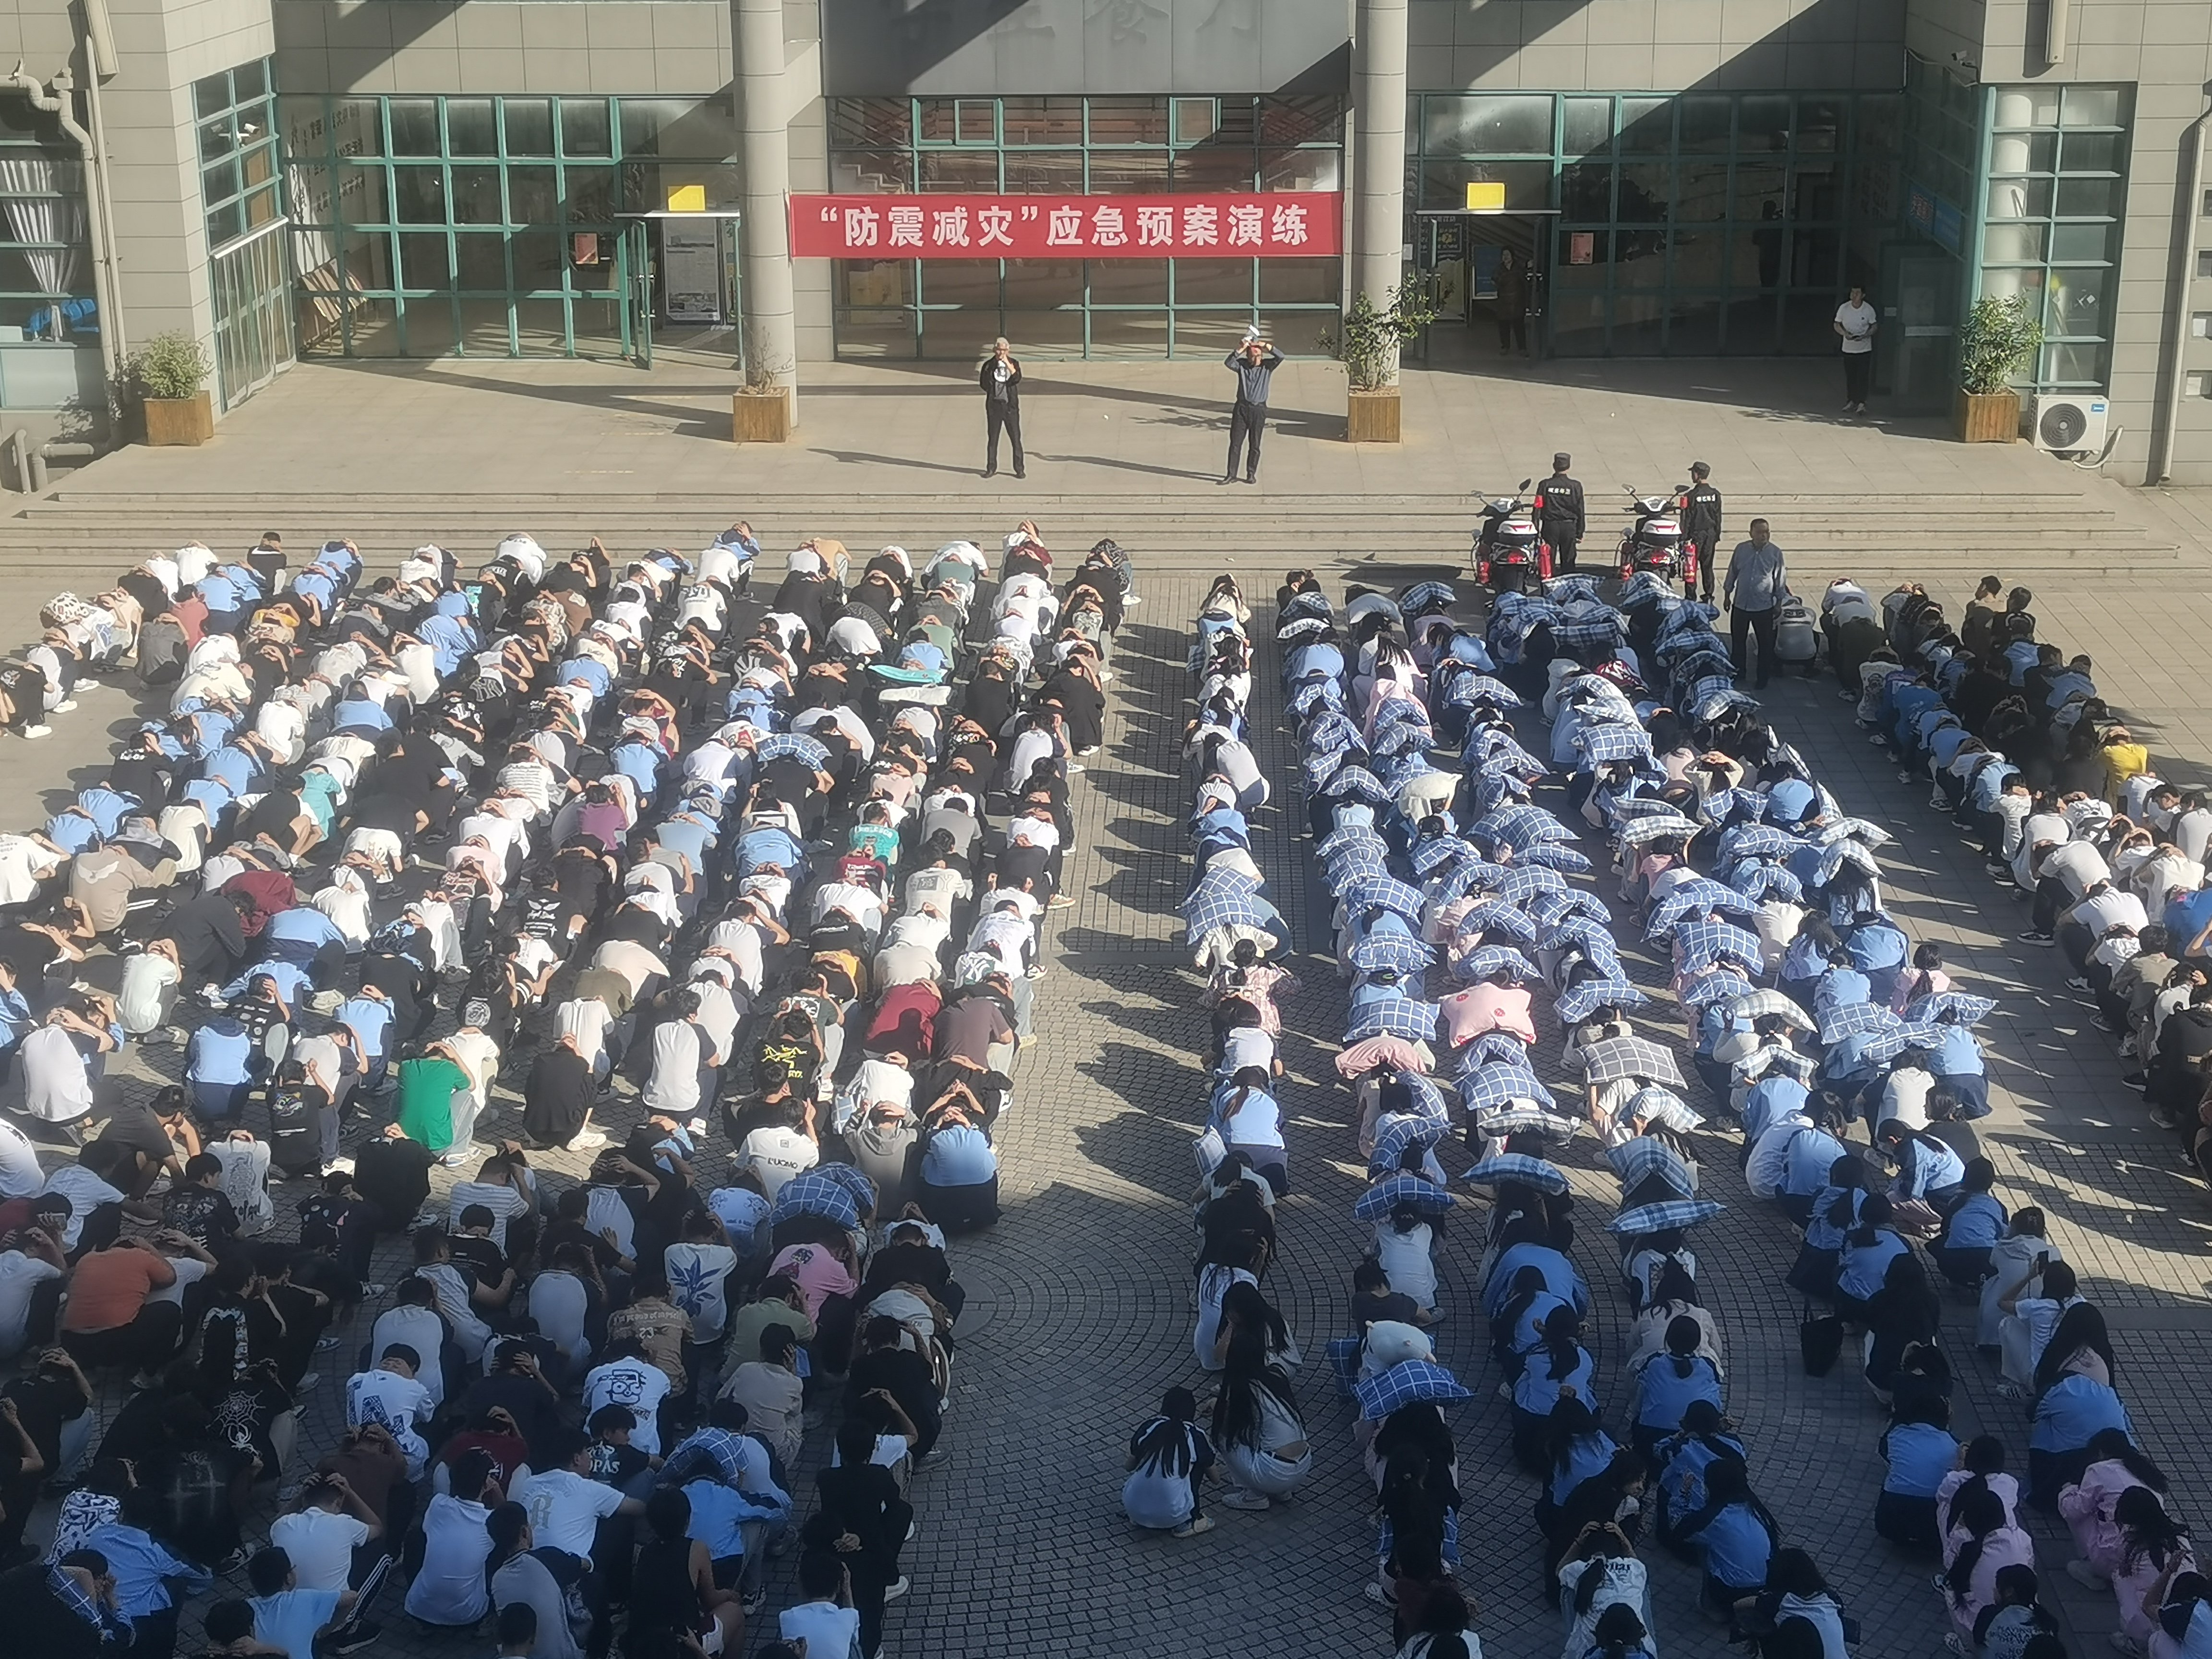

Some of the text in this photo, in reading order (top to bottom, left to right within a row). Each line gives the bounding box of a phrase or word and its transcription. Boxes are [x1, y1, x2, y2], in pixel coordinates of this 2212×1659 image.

[821, 204, 1309, 248] “防震减灾”应急预案演练
